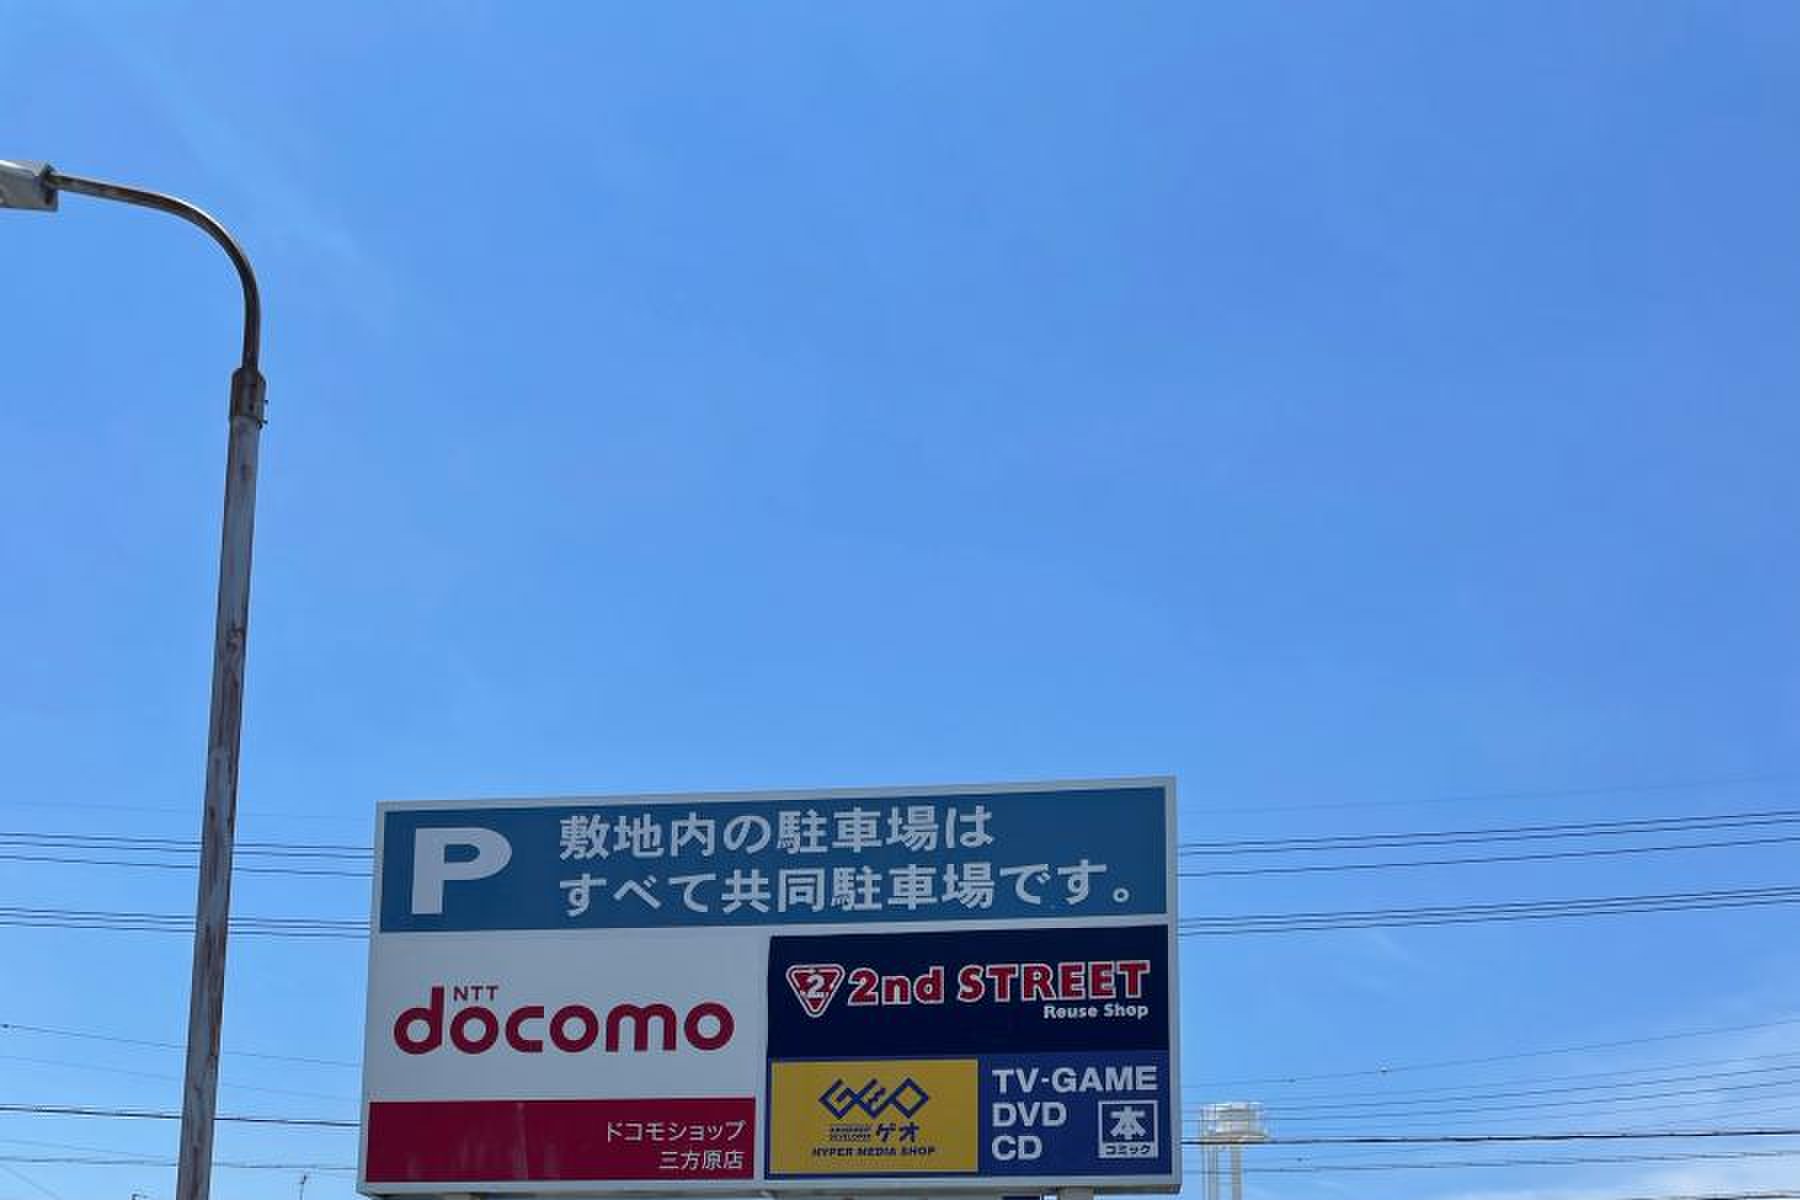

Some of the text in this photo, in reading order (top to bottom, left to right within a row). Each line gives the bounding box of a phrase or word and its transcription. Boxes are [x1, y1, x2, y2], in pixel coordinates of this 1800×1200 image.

[559, 804, 994, 861] 敷地内の駐車場は
[411, 827, 513, 915] P
[559, 859, 1131, 917] すべて共同駐車場です。
[453, 985, 499, 1001] NTT
[847, 959, 1151, 1006] 2nd STREET
[393, 986, 735, 1055] docomo
[1043, 1002, 1149, 1020] Reuse Shop
[991, 1066, 1159, 1094] TV-GAME
[991, 1102, 1068, 1127] DVD
[1109, 1105, 1147, 1140] 本
[607, 1120, 746, 1143] ドコモショップ
[875, 1121, 920, 1142] ゲオ
[659, 1150, 745, 1171] 三方原店
[811, 1146, 936, 1158] HYPER MEDIA SHOP
[991, 1135, 1043, 1161] CD
[1105, 1144, 1152, 1155] コミック
